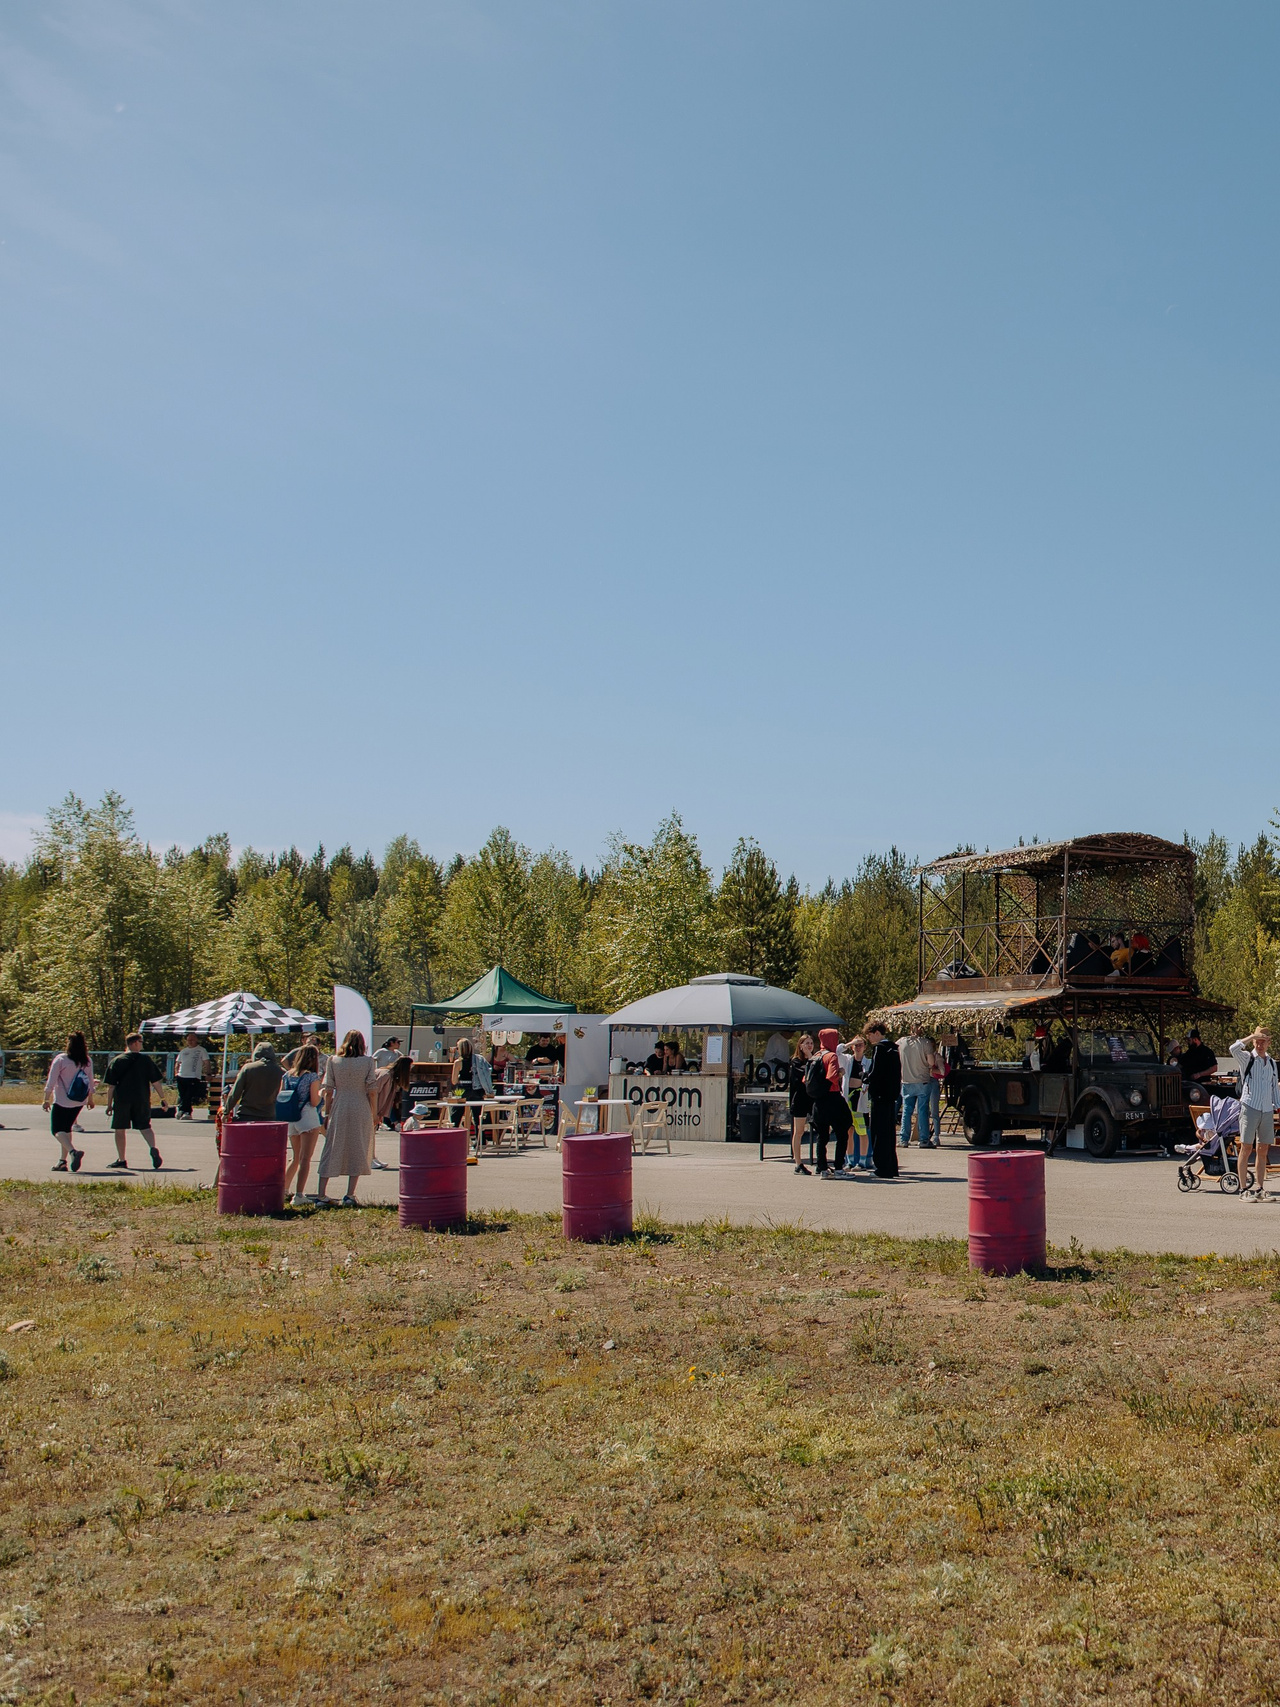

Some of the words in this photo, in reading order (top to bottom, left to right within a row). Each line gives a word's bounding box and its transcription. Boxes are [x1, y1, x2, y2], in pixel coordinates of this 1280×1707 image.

[749, 1054, 792, 1091] lag
[623, 1078, 702, 1113] lagom
[666, 1110, 701, 1127] bistro
[1125, 1112, 1144, 1120] RENT
